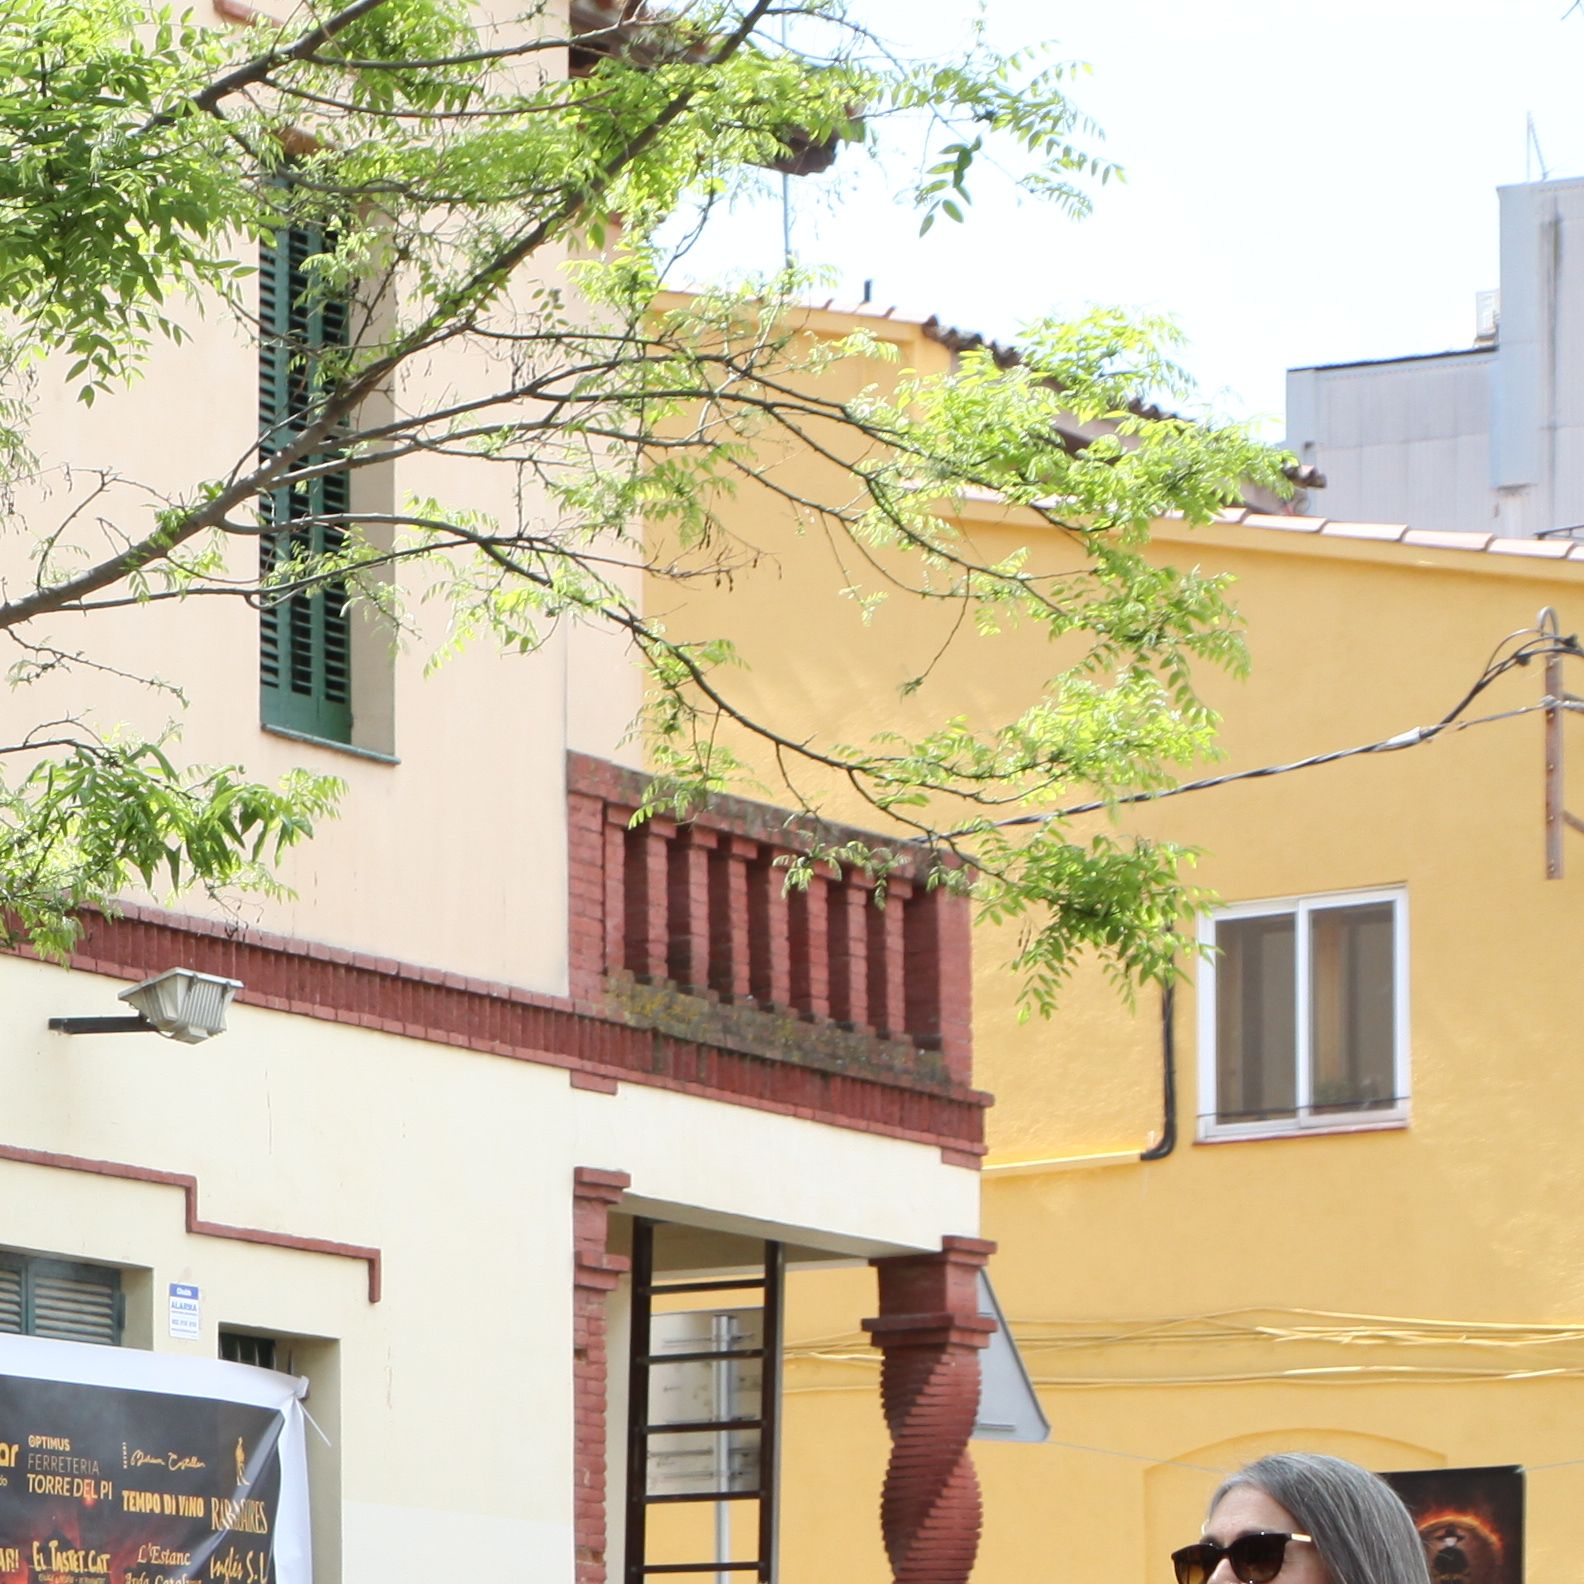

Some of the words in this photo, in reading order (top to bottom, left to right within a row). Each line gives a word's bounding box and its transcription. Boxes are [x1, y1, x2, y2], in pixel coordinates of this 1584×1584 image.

[28, 1434, 70, 1451] OPTIMUS
[27, 1453, 100, 1475] FERRETERIA
[27, 1473, 71, 1496] TORRE
[73, 1479, 98, 1499] DEL
[100, 1480, 113, 1499] PI
[122, 1489, 161, 1514] TEMPO
